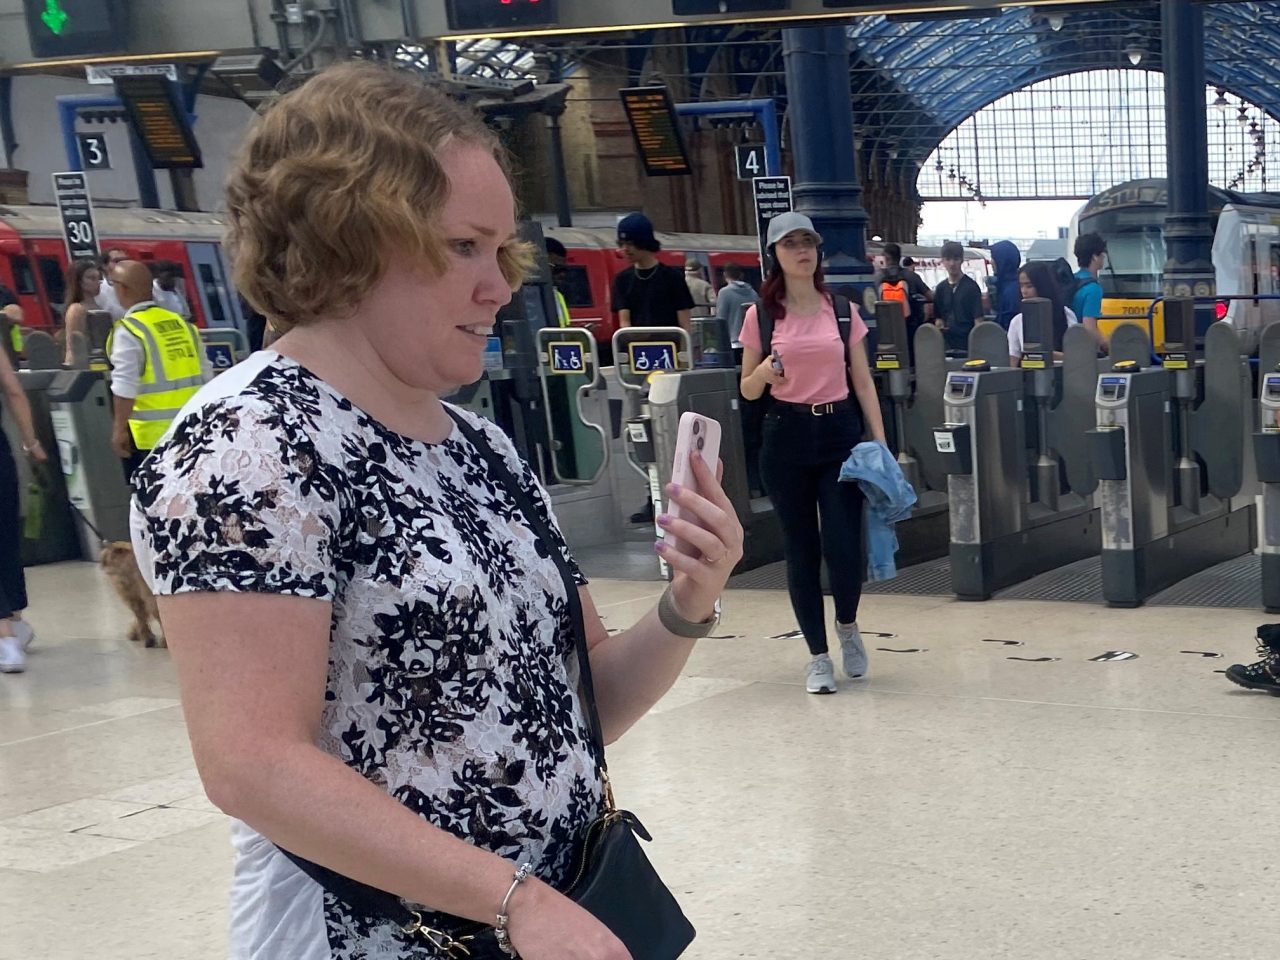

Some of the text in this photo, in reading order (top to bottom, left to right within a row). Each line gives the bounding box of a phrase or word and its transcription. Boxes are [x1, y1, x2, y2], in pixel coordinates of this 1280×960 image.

[86, 138, 102, 164] 3
[745, 150, 759, 174] 4
[68, 221, 92, 243] 30
[1122, 306, 1158, 315] 70014
